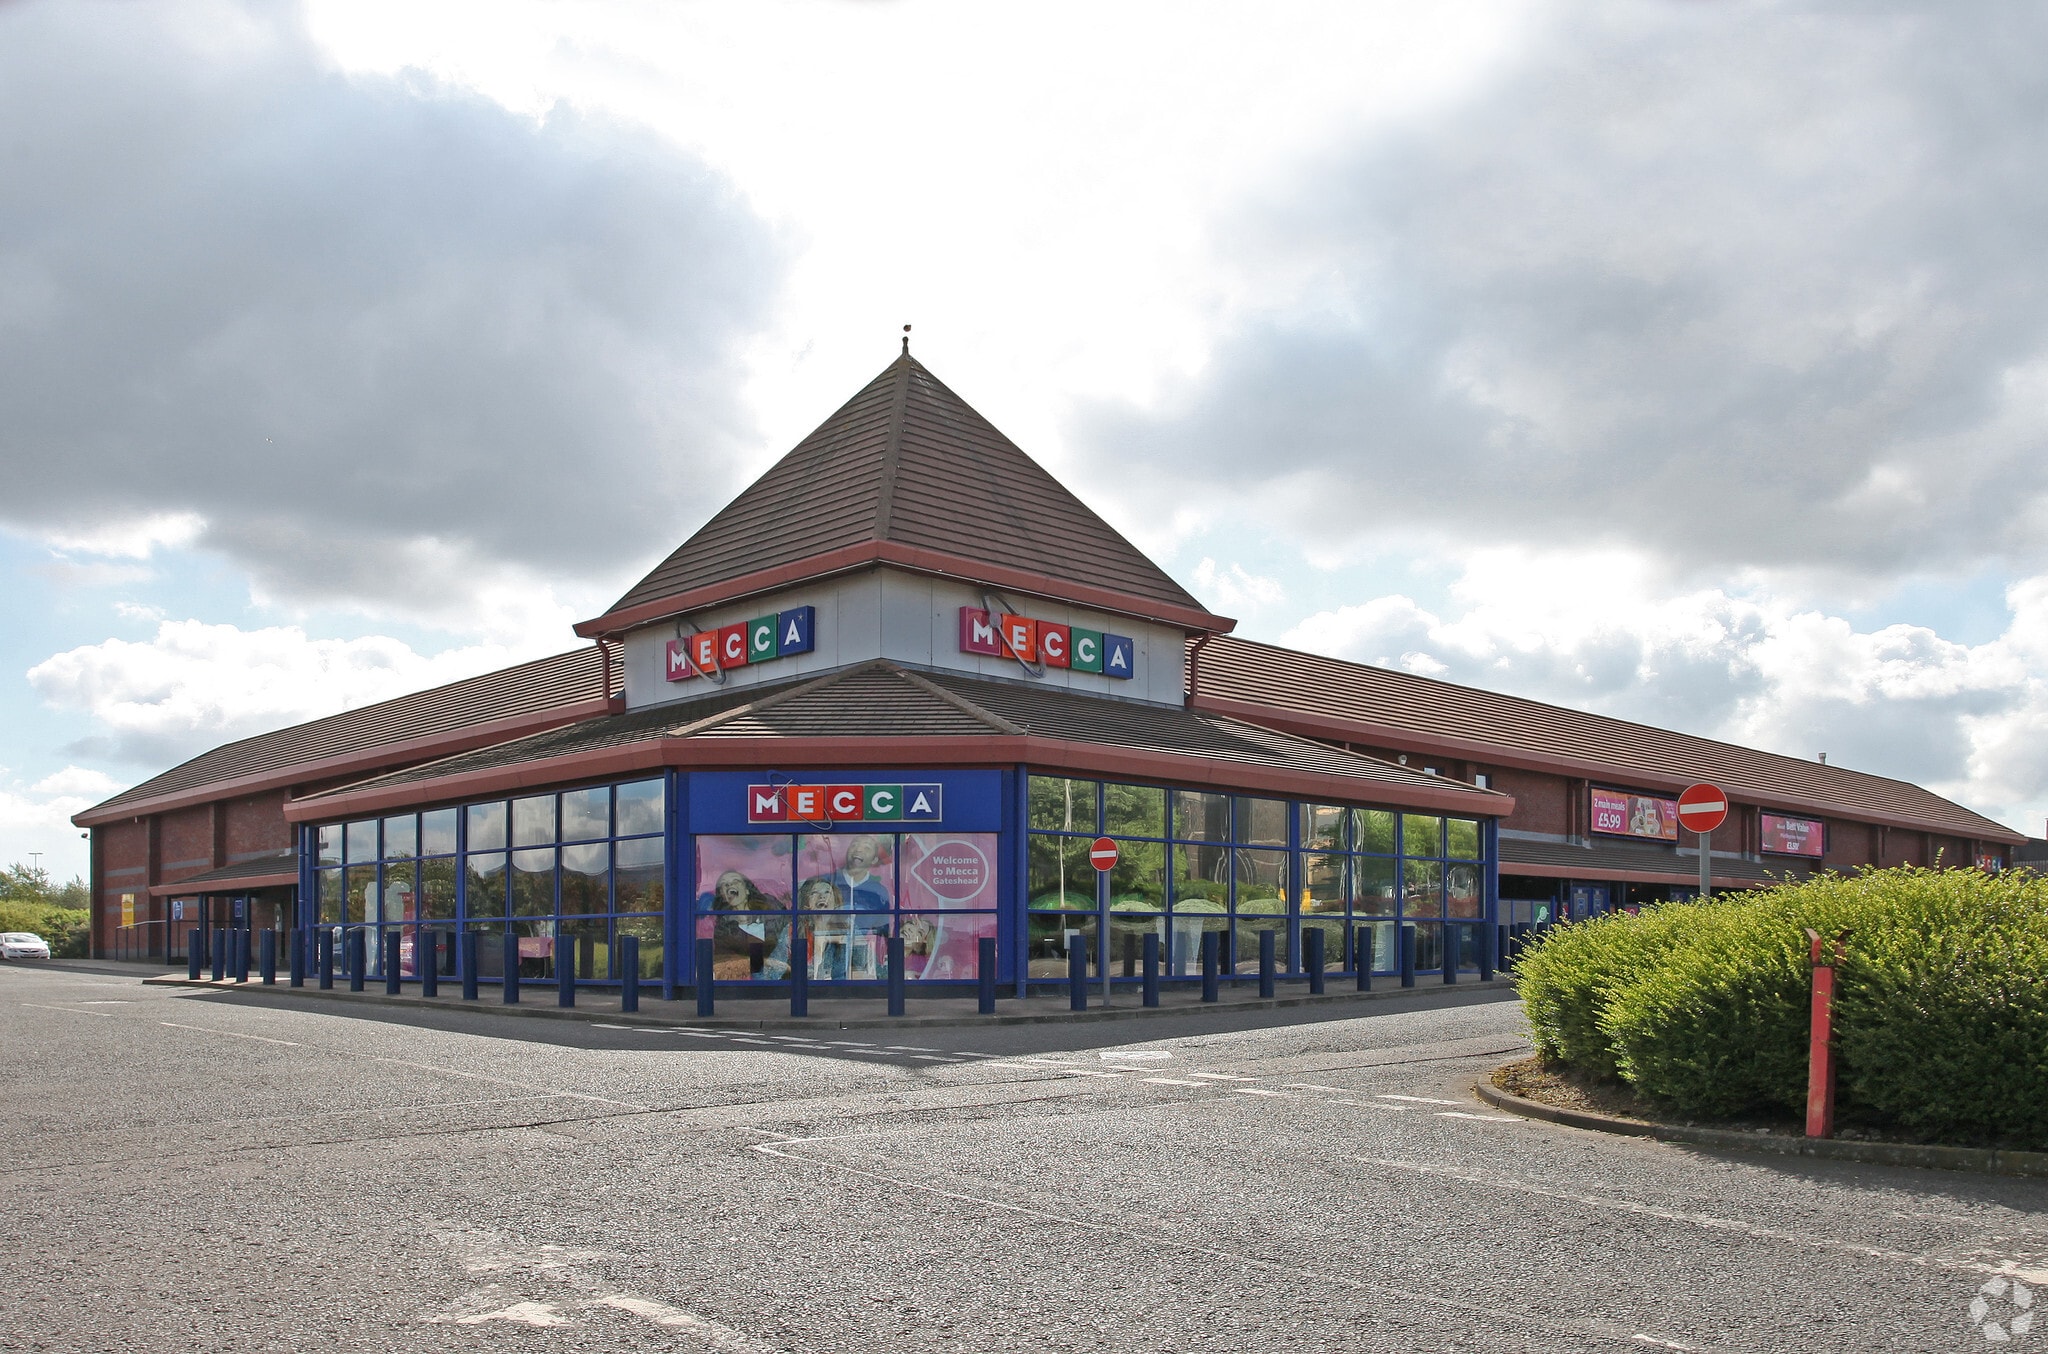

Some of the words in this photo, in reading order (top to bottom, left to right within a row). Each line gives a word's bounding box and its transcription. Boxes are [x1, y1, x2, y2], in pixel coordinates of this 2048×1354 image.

[670, 619, 801, 673] MECCA
[972, 617, 1127, 670] MECCA
[755, 790, 933, 814] MECCA
[1598, 812, 1621, 829] £5.99
[933, 856, 979, 865] Welcome
[933, 867, 944, 876] to
[945, 867, 979, 876] Mecca
[933, 876, 979, 885] Gateshead
